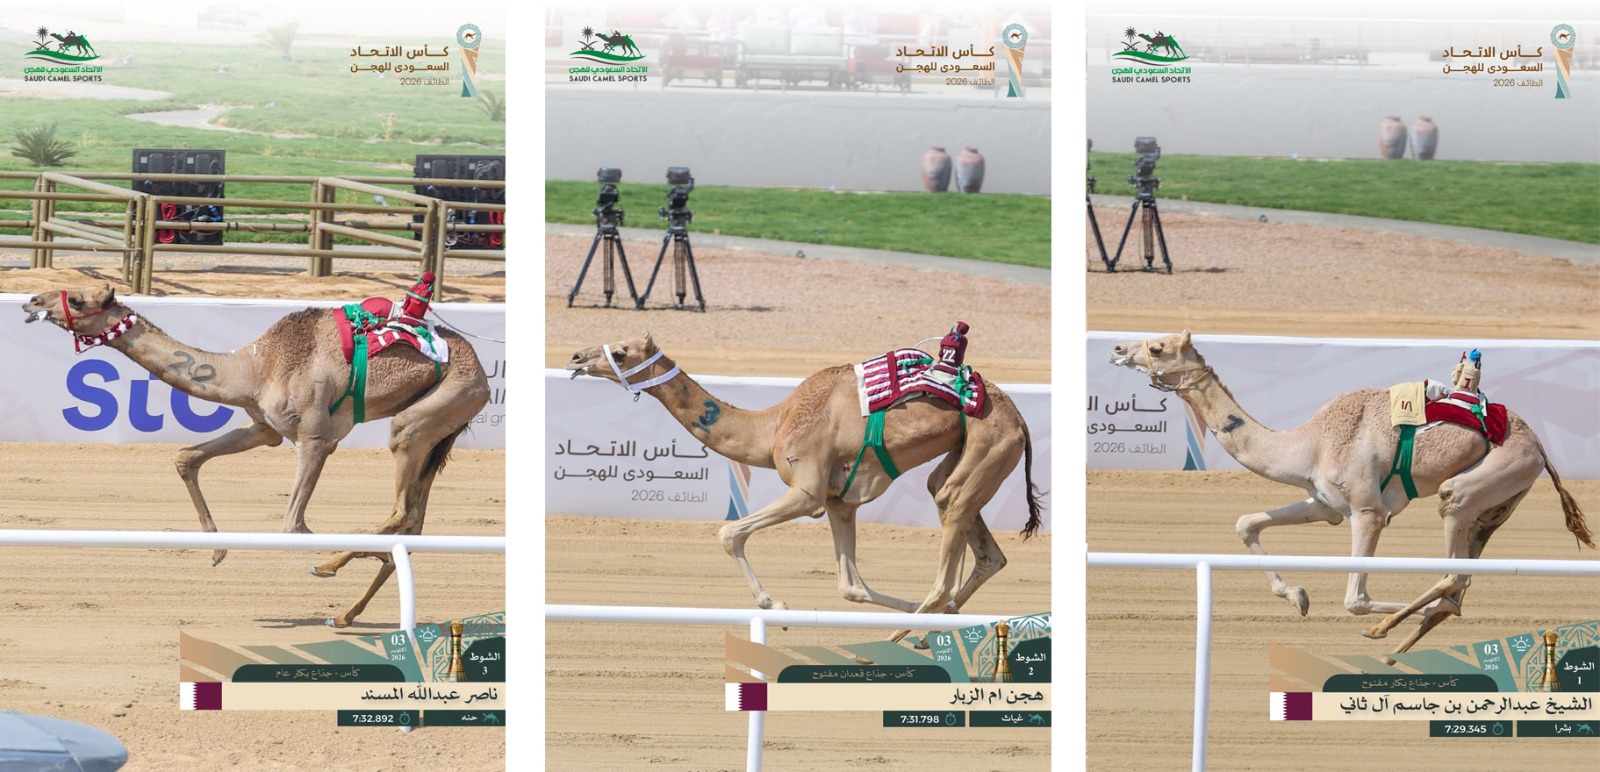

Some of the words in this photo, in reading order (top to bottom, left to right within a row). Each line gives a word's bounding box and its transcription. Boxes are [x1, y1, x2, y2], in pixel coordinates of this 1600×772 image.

[1105, 393, 1167, 415] كأس
[554, 440, 637, 458] الاتحاد
[644, 438, 709, 462] كأس
[1093, 442, 1126, 453] 2026
[1128, 443, 1166, 454] الطائف
[554, 464, 618, 482] للهجن
[631, 489, 665, 502] 2026
[668, 489, 708, 503] الطائف
